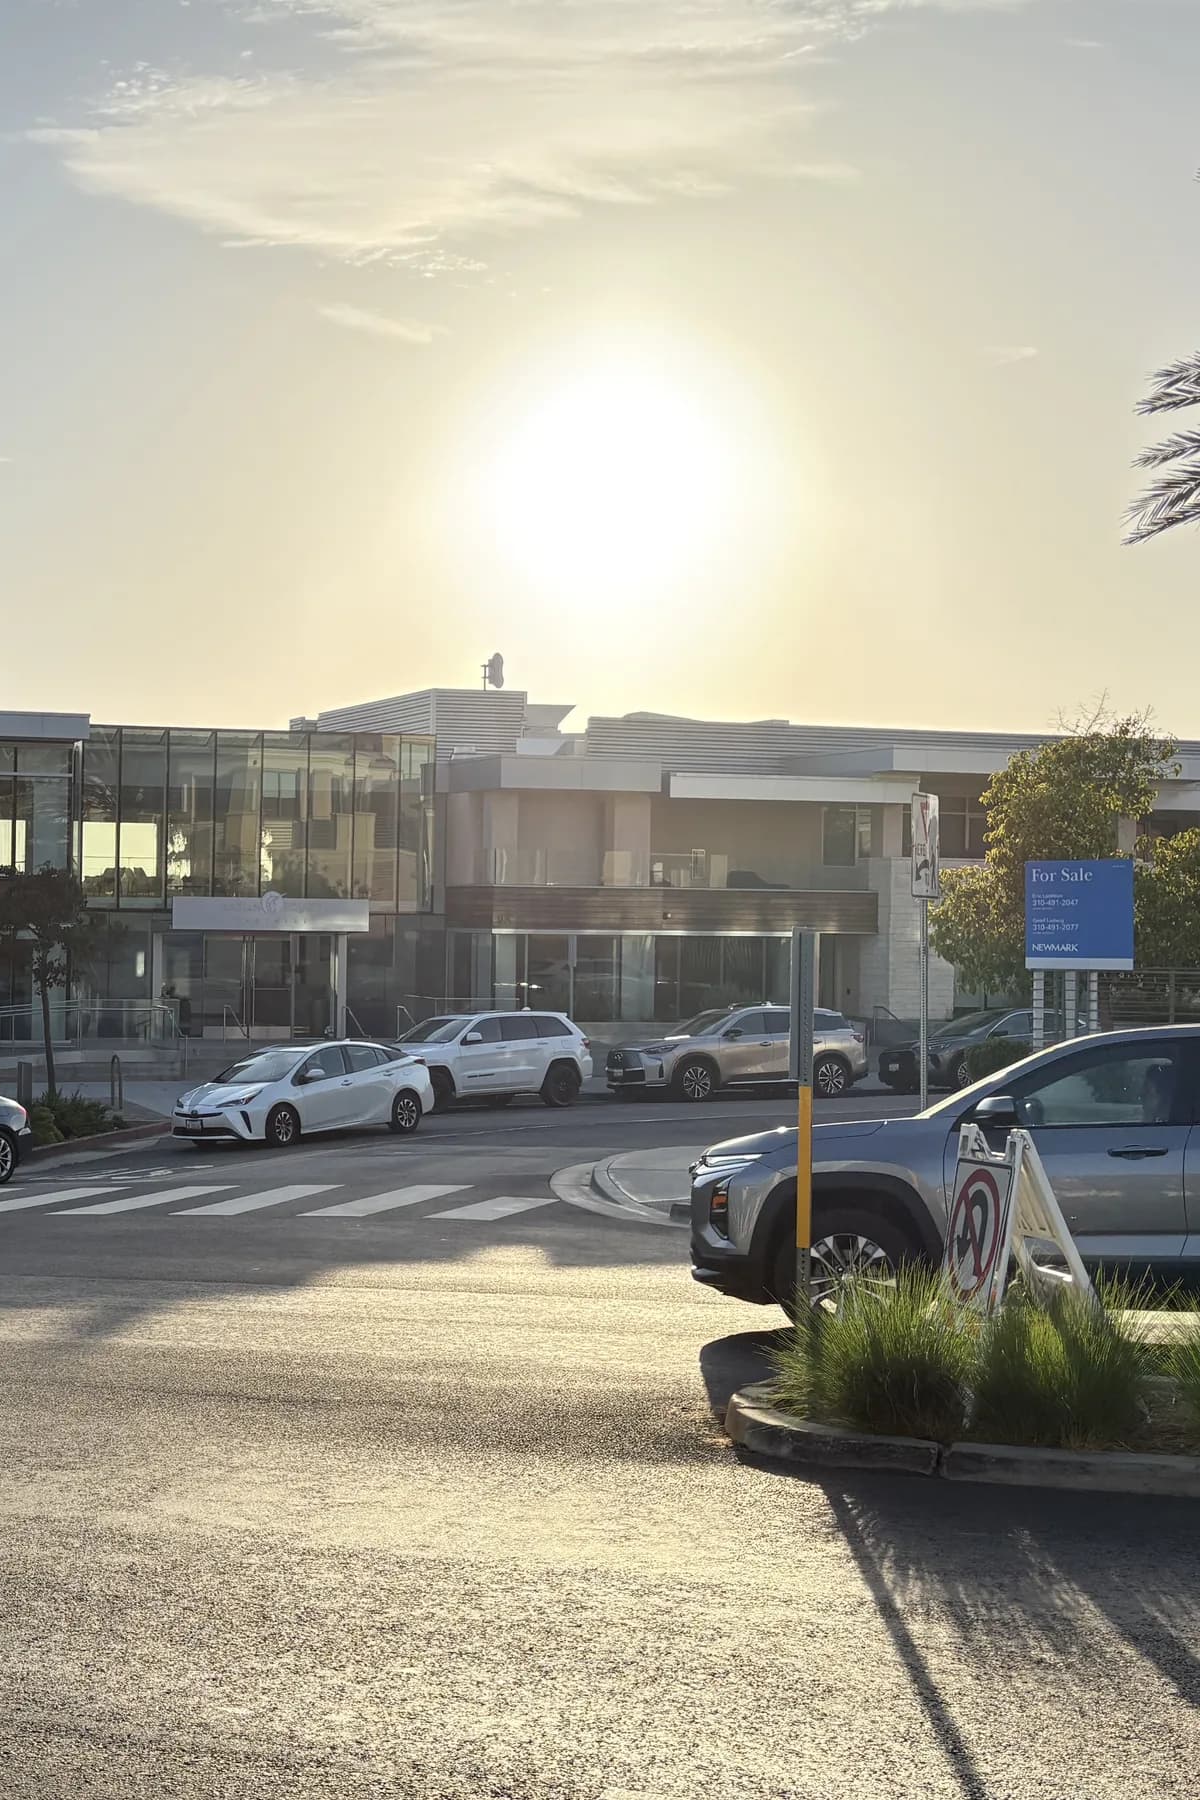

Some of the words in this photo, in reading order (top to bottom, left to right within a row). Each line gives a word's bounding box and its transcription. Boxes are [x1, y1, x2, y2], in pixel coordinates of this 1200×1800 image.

[1031, 868, 1057, 882] For
[1060, 867, 1094, 882] Sale
[1031, 943, 1079, 952] NEWMARK
